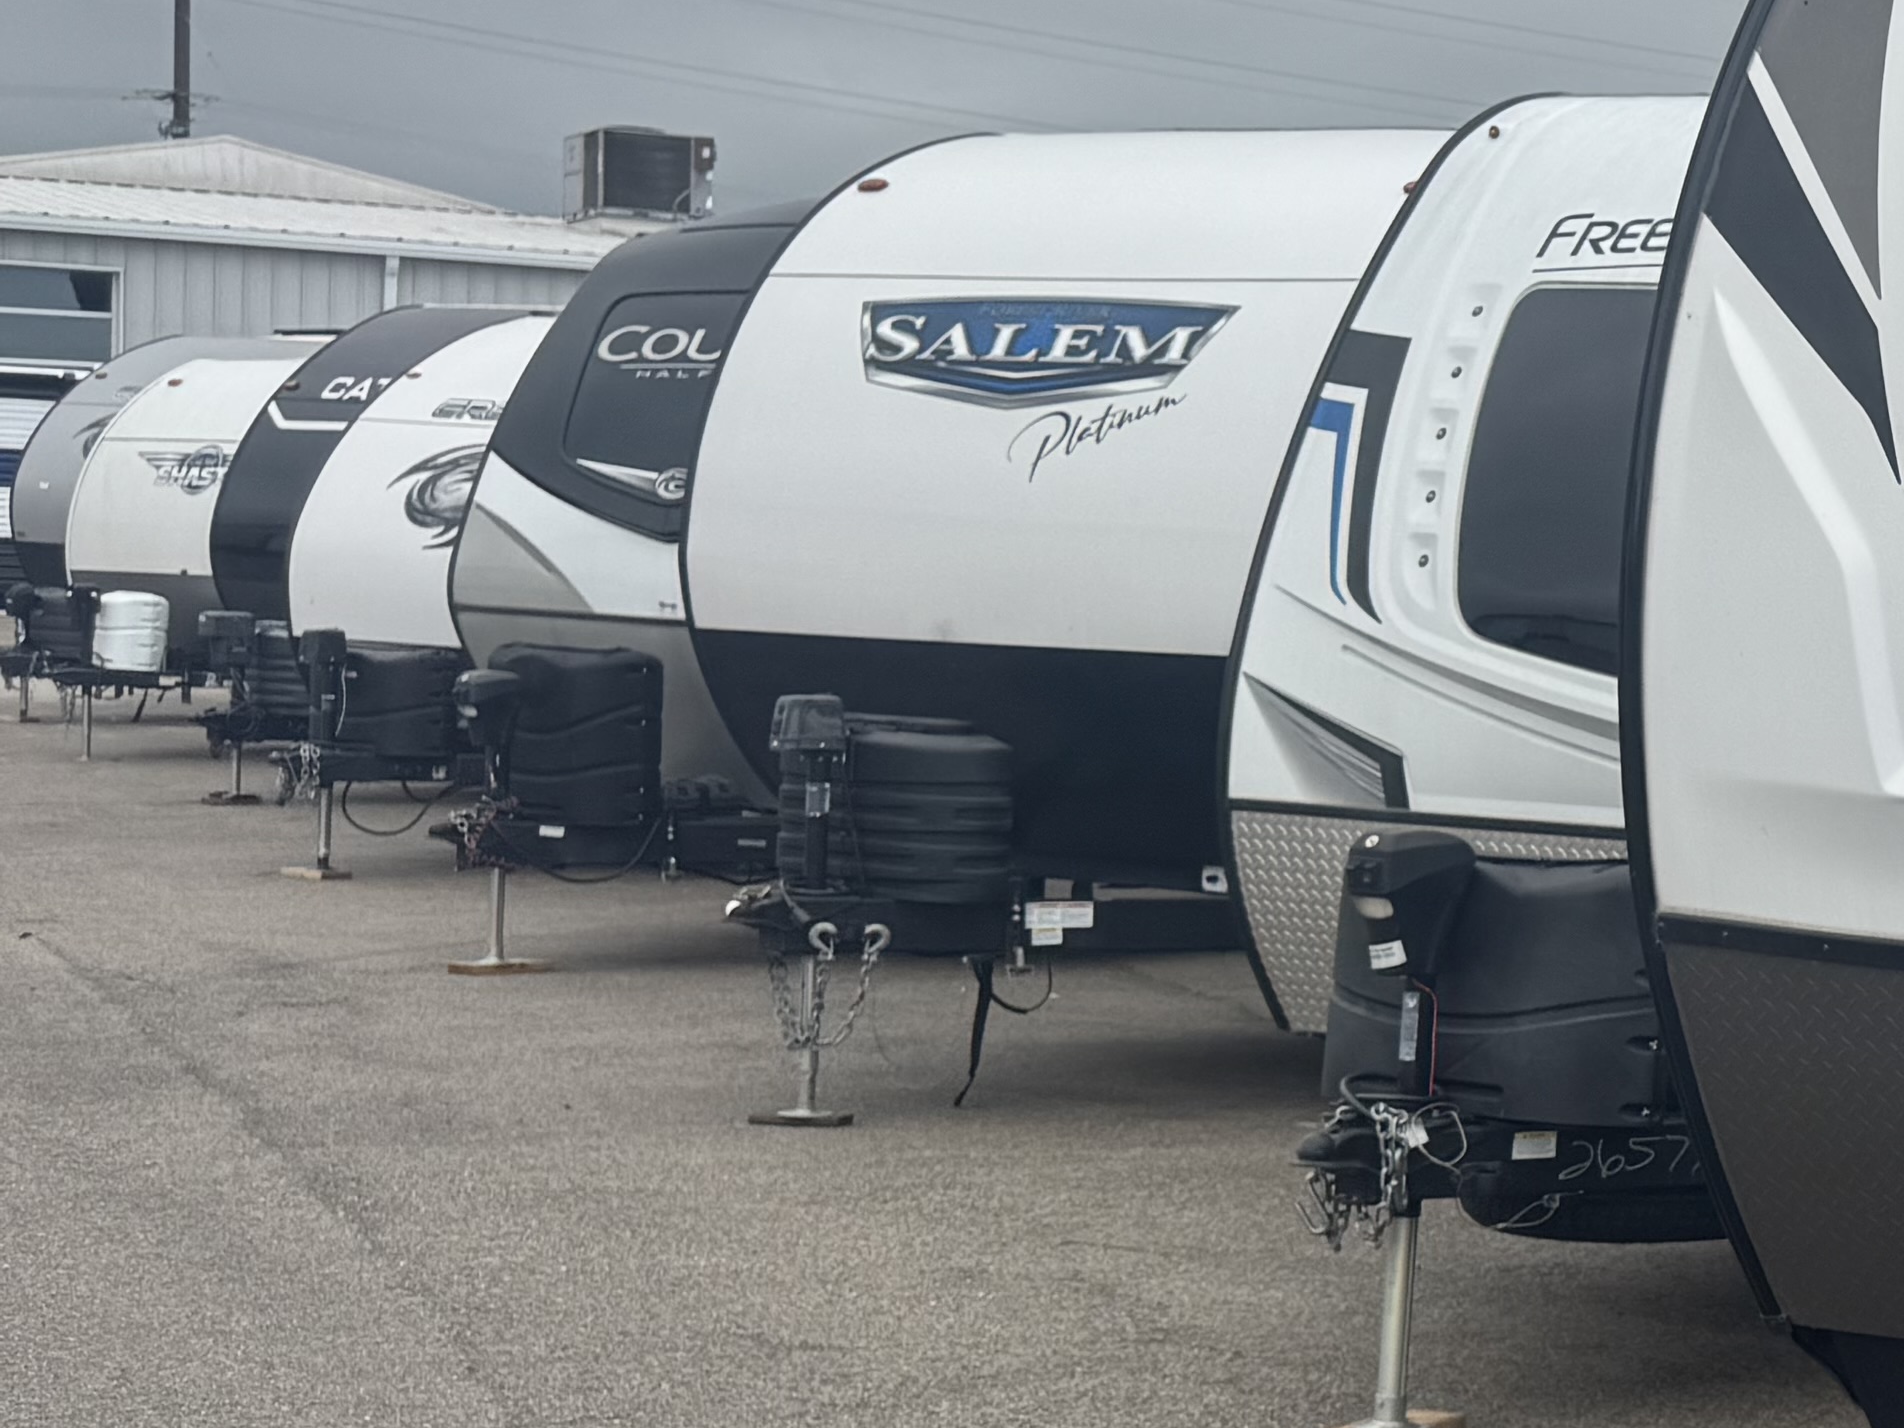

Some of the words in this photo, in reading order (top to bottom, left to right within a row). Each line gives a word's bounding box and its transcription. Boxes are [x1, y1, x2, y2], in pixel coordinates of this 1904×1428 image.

[1535, 212, 1675, 258] FREE
[865, 314, 1203, 366] SALEM
[1006, 392, 1187, 483] Platinum
[1558, 1134, 1702, 1181] 2657
